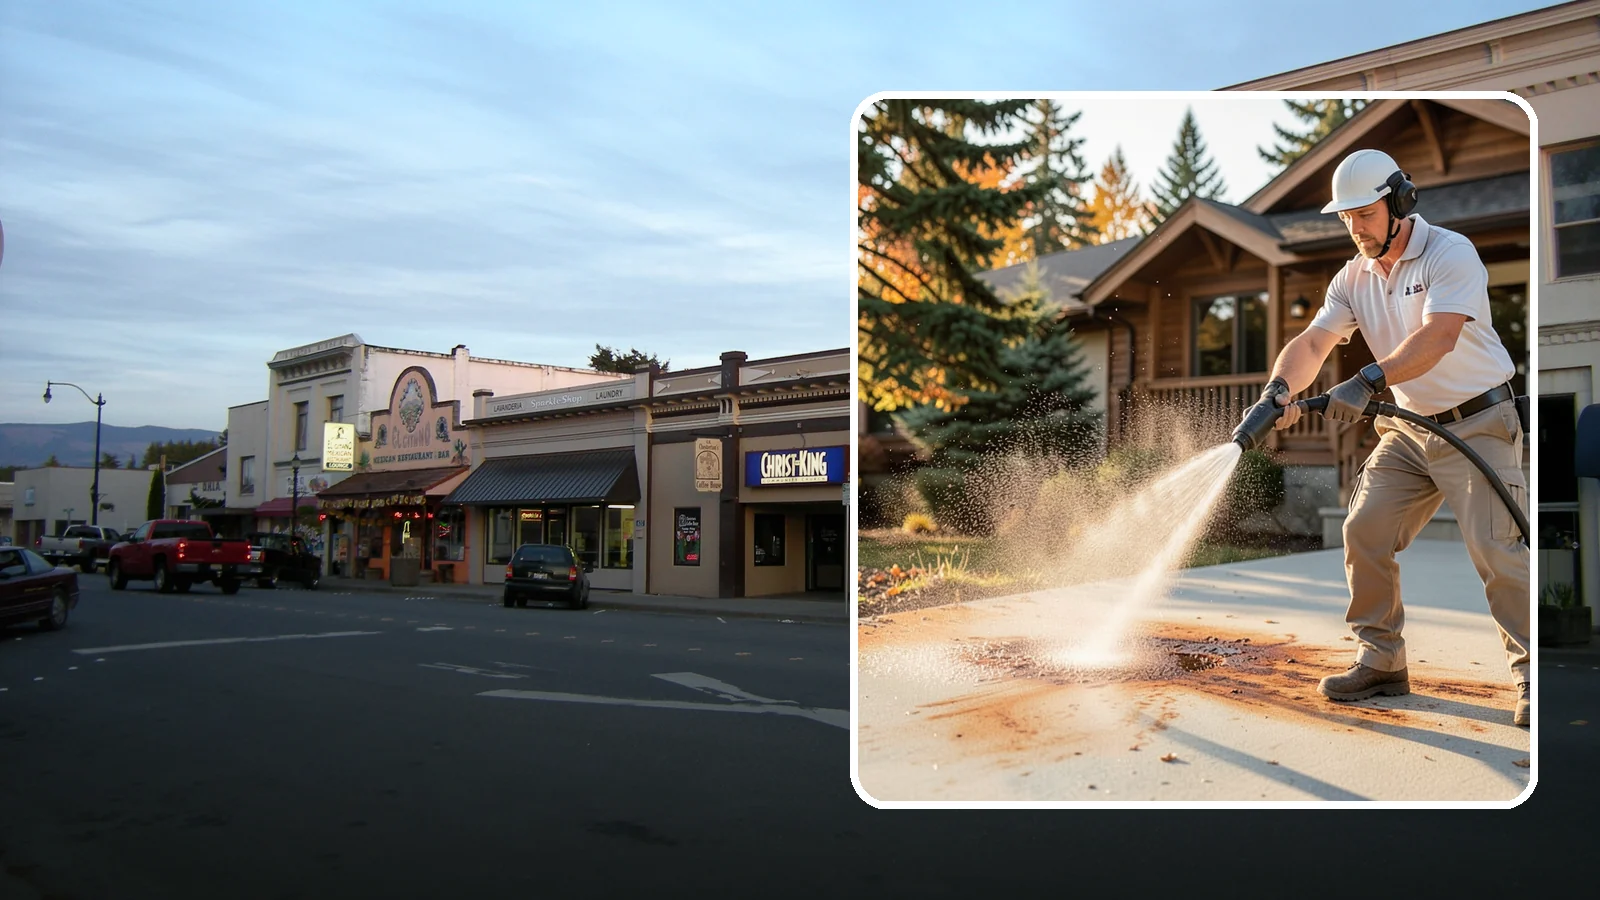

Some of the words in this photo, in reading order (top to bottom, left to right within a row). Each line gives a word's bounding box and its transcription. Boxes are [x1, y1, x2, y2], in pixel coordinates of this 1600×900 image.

[595, 389, 623, 400] LAUNDRY
[493, 402, 522, 412] LAVANDERIA
[530, 398, 560, 409] Sparkle
[561, 395, 582, 404] Shop
[373, 454, 396, 464] MEXICAN
[397, 451, 434, 462] RESTAURANT
[438, 450, 450, 459] BAR
[799, 450, 827, 476] KING
